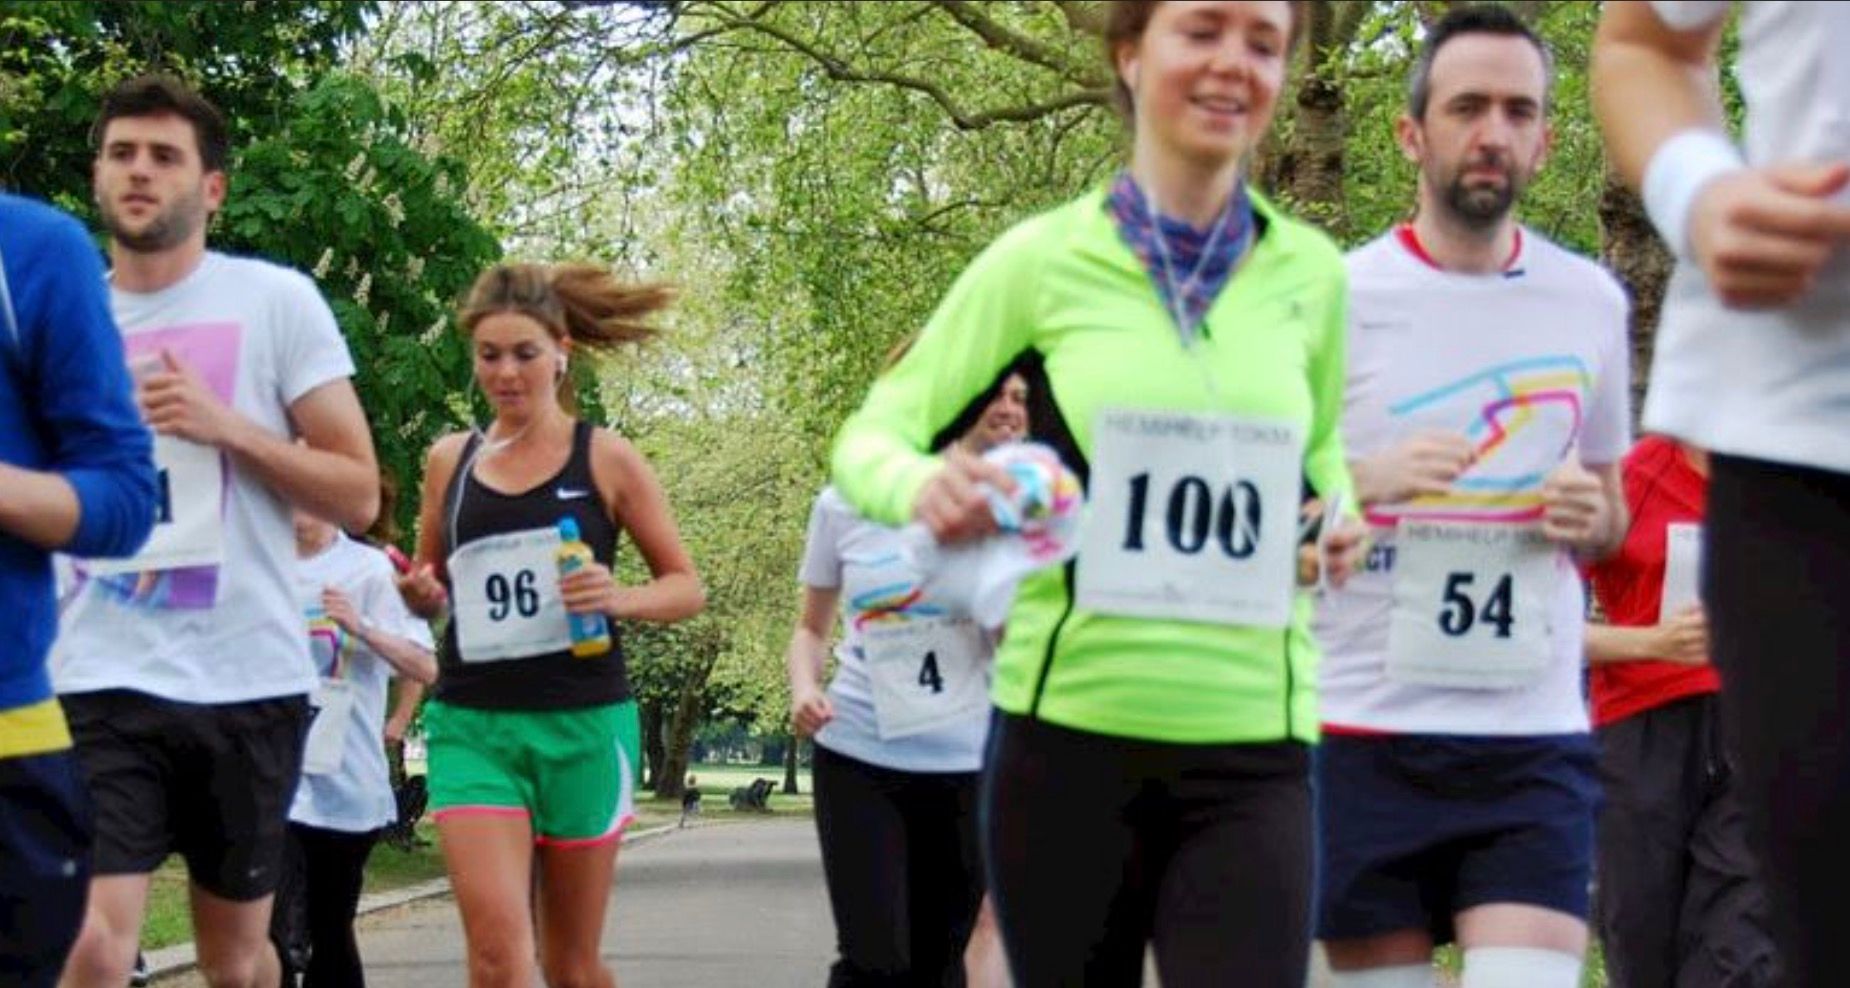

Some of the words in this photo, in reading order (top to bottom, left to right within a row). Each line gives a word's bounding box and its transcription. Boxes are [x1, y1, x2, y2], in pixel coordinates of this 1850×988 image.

[1122, 471, 1262, 560] 100
[485, 568, 540, 622] 96
[1437, 571, 1514, 638] 54
[918, 650, 944, 694] 4
